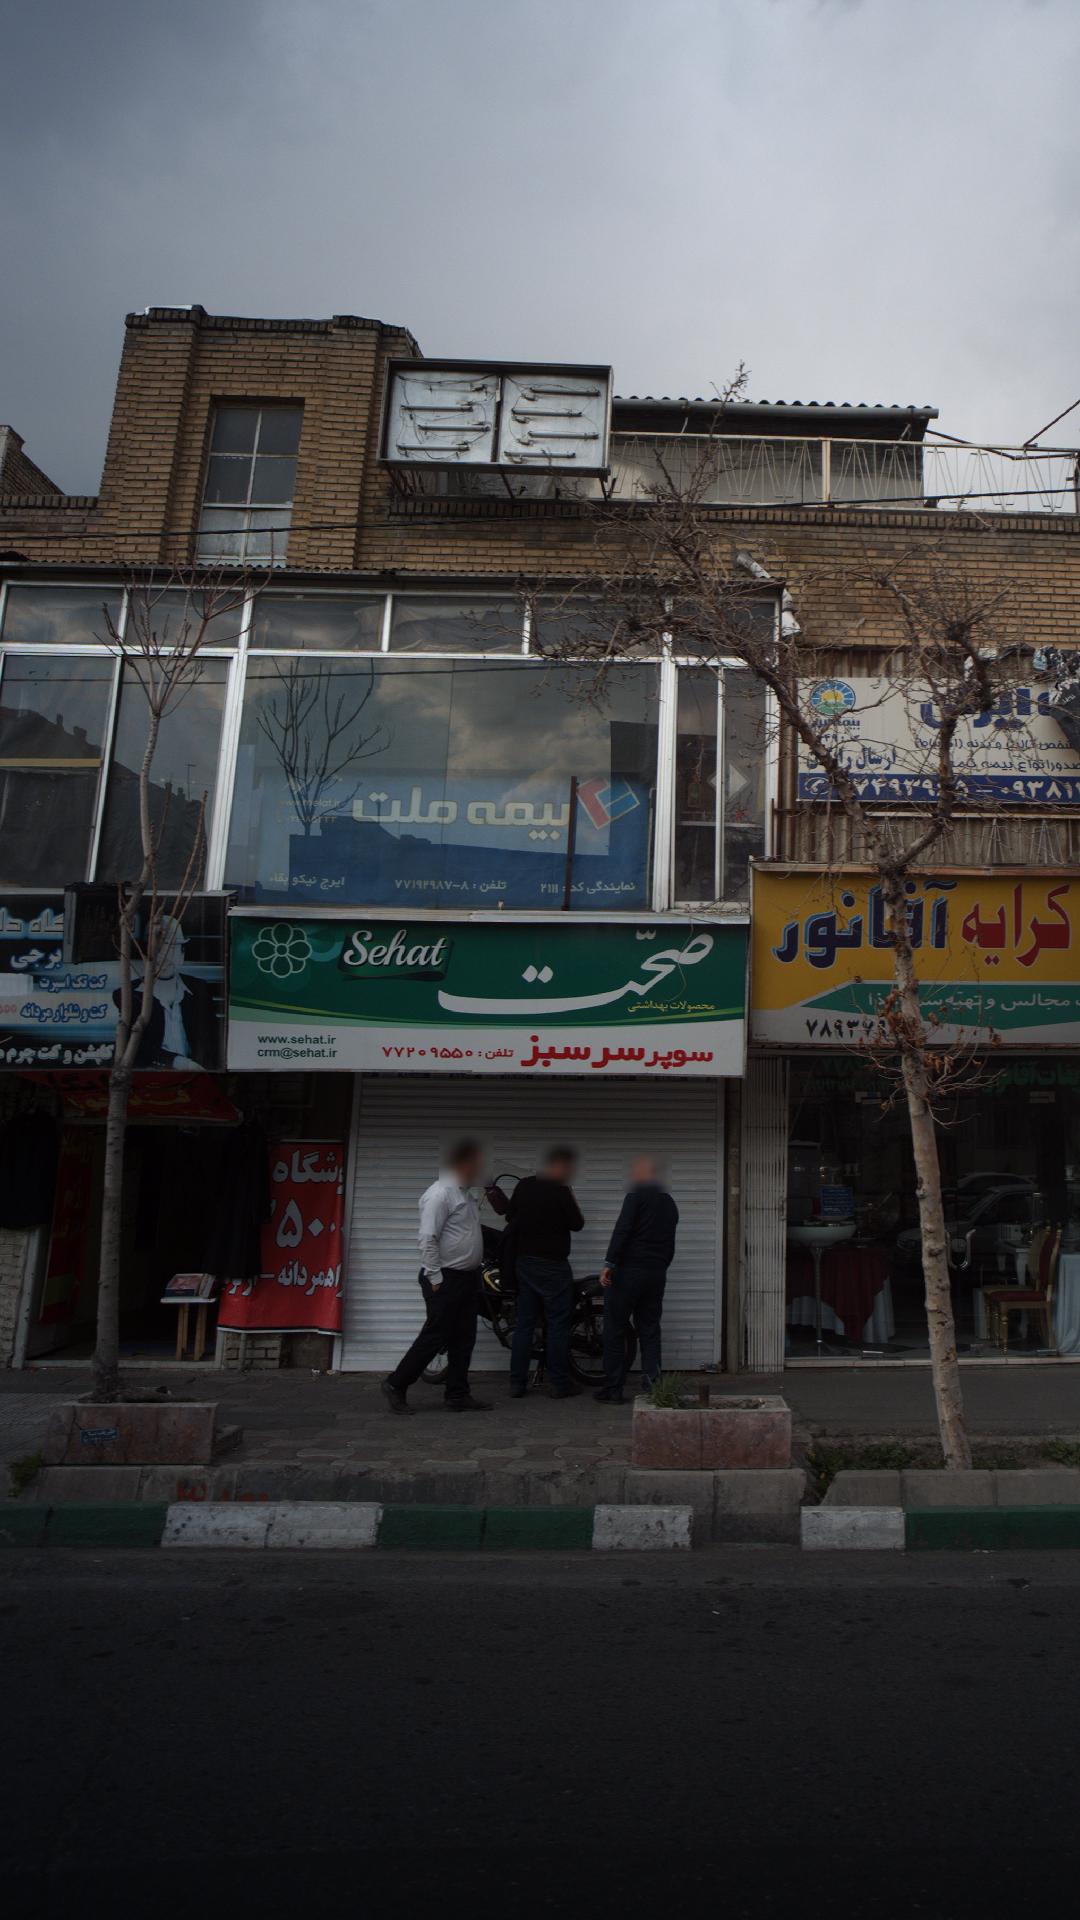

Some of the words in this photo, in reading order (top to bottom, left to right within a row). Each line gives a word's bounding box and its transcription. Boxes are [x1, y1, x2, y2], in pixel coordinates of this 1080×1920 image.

[352, 785, 458, 826] ملت
[467, 800, 571, 841] بیمه
[587, 880, 636, 895] نمایندگی
[961, 883, 1071, 967] کرایه
[343, 929, 448, 967] Sehat
[627, 999, 669, 1013] بهداشتی
[669, 1000, 717, 1013] محصولات
[1000, 992, 1071, 1011] مجالس
[257, 1034, 337, 1045] www.sehat.ir
[257, 1047, 338, 1060] crm@sehat.ir
[382, 1046, 473, 1059] ۷۷۲۰۹۵۵۰
[645, 1049, 714, 1069] سوپر
